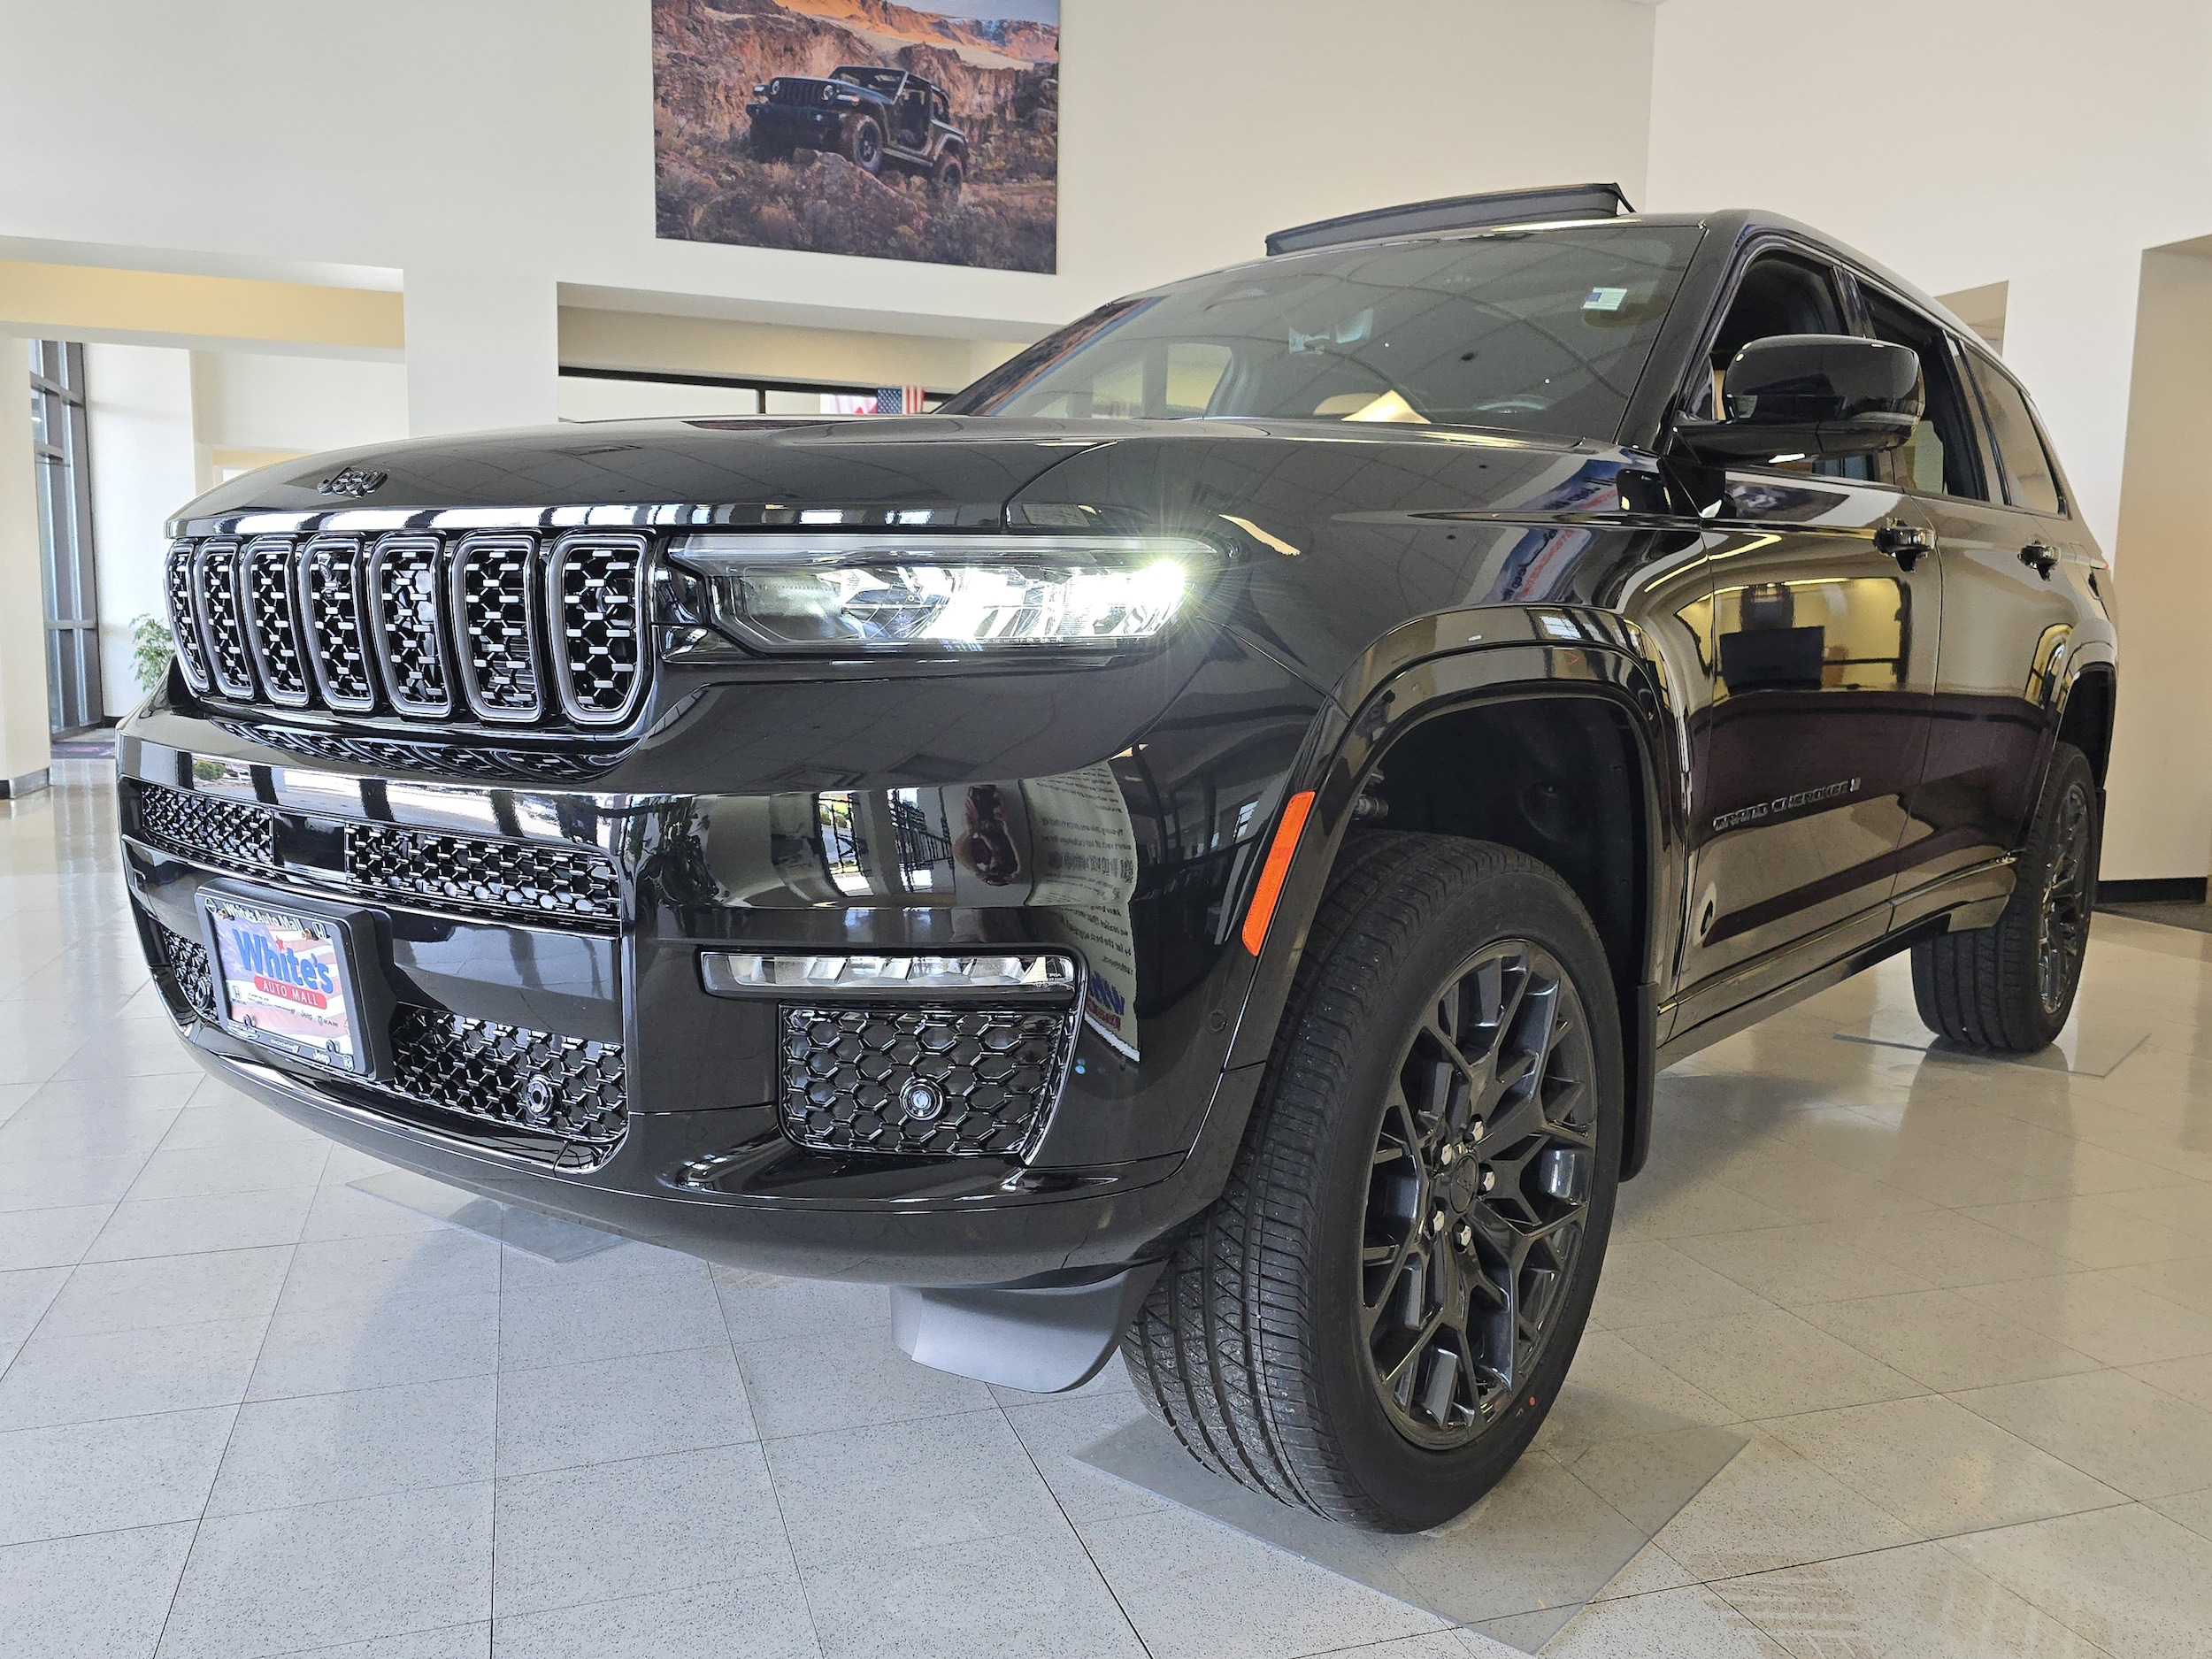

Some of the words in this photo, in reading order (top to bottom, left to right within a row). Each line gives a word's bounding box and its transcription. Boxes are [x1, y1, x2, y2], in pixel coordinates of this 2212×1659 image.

[224, 902, 256, 921] White's
[256, 910, 279, 926] Auto
[279, 915, 303, 932] Mall
[233, 929, 334, 994] White's
[262, 980, 288, 998] AUTO
[291, 987, 319, 1006] MALL
